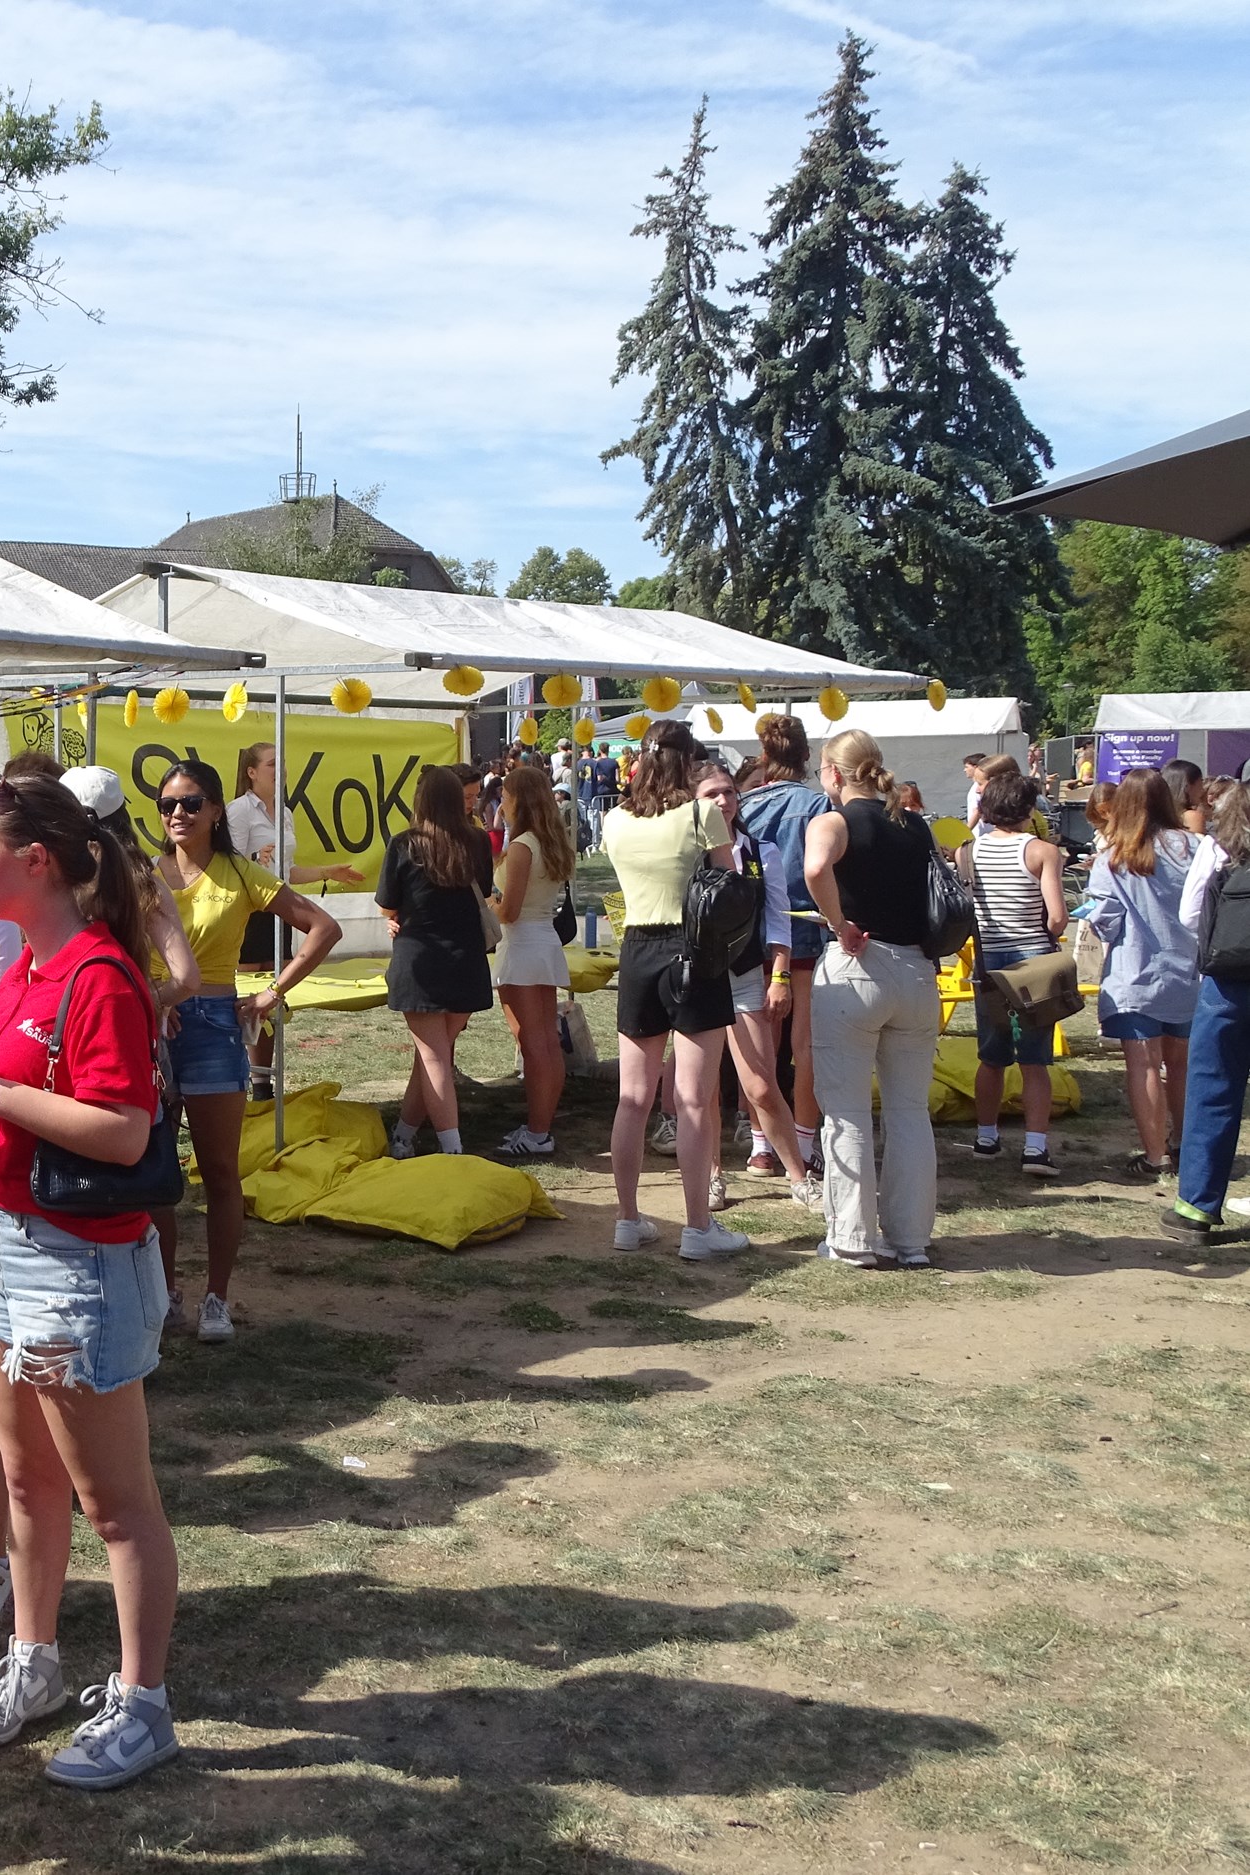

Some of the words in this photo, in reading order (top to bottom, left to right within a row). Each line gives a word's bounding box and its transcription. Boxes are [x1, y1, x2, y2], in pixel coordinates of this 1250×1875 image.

[1104, 733, 1128, 744] Sign
[1130, 735, 1144, 744] up
[1147, 733, 1175, 742] now!
